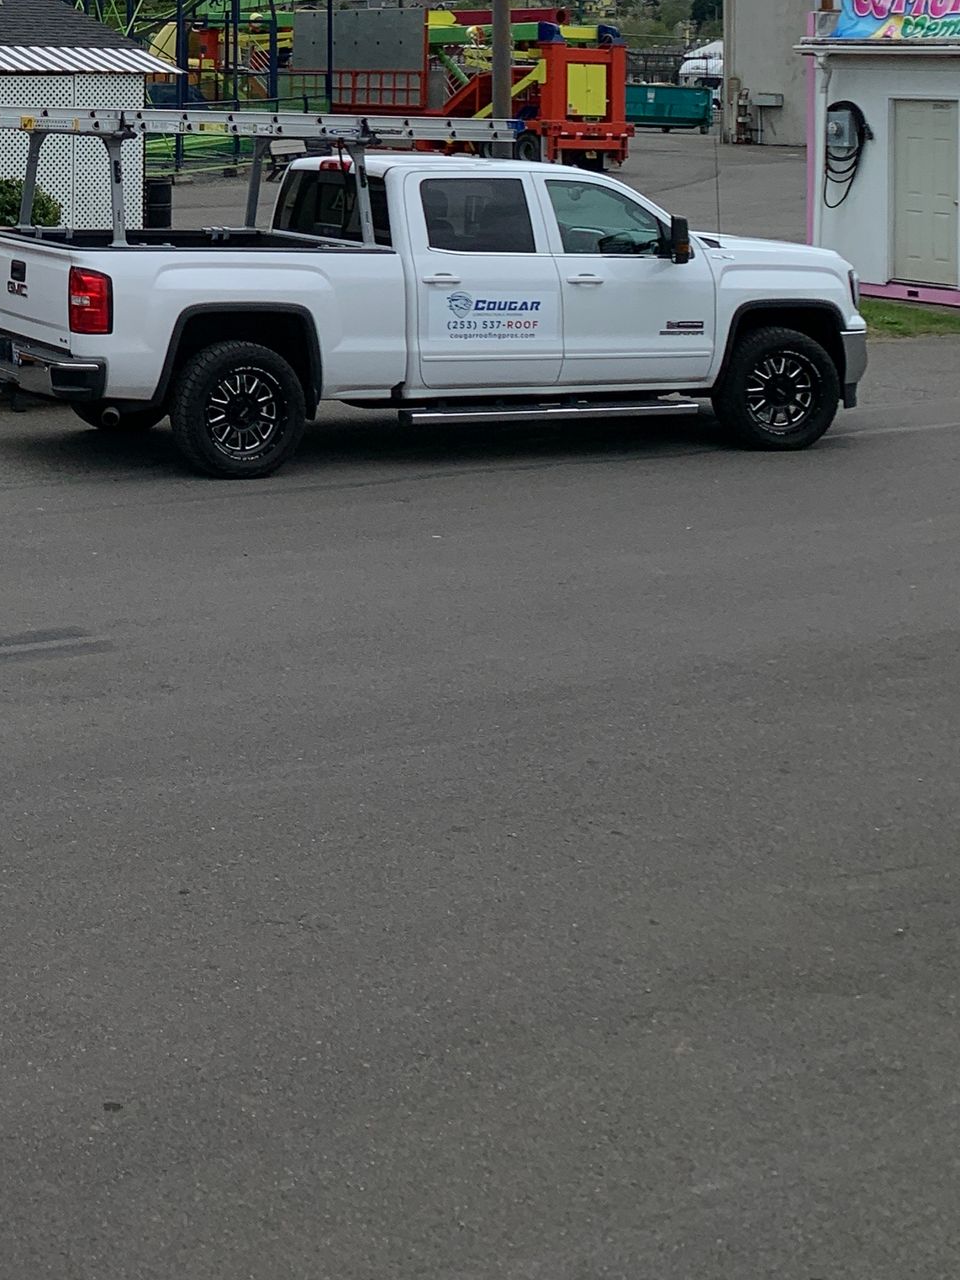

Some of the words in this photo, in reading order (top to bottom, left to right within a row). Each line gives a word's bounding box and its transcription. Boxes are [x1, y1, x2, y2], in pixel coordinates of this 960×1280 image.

[901, 14, 960, 38] Lem
[7, 280, 28, 298] GMC
[473, 299, 541, 311] COUGAR
[447, 320, 477, 330] (253)
[482, 320, 539, 330] 537-ROOF
[449, 332, 536, 340] cougarroofingpros.com
